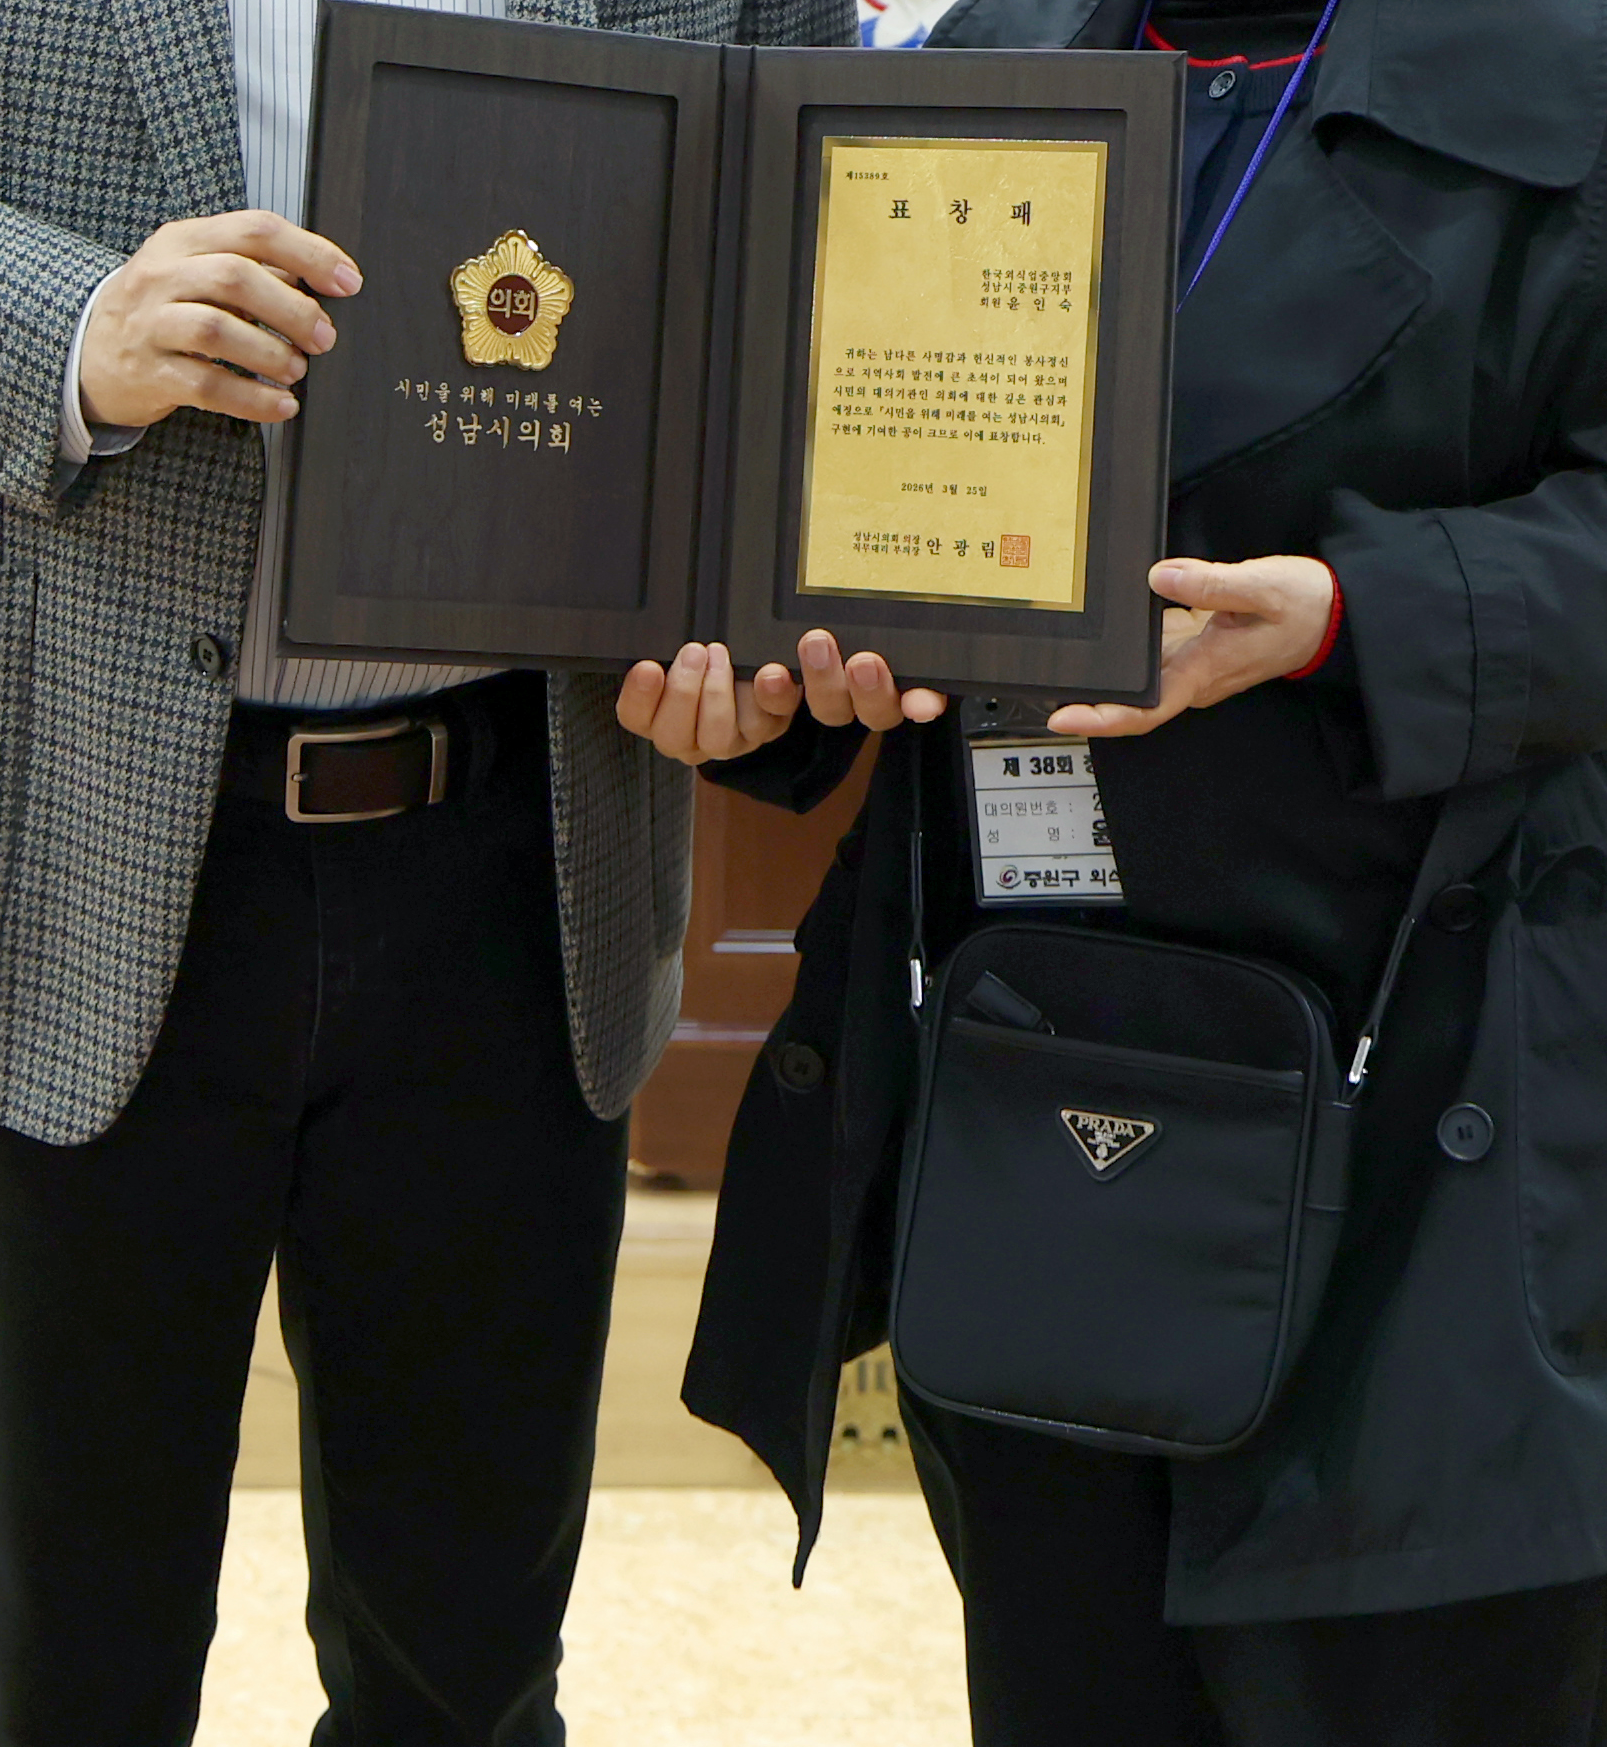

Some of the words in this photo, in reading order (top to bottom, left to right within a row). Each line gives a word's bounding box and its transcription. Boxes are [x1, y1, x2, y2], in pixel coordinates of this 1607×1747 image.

[981, 268, 1072, 283] 한국외식업중앙회
[981, 281, 1012, 293] 성남시
[1017, 282, 1072, 295] 중원구지부
[488, 288, 536, 321] 의회
[980, 296, 1001, 308] 회원
[845, 348, 877, 360] 귀하는
[884, 349, 916, 361] 남다른
[922, 351, 966, 364] 사명감과
[973, 353, 1016, 366] 헌신적인
[1024, 355, 1068, 368] 봉사정신
[834, 367, 855, 377] 으로
[862, 367, 905, 380] 지역사회
[912, 370, 944, 382] 발전에
[951, 371, 960, 383] 큰
[967, 372, 999, 384] 초석이
[1007, 374, 1028, 386] 되어
[1034, 374, 1067, 387] 왔으며
[394, 378, 451, 404] 시민을
[459, 385, 495, 408] 위해
[505, 389, 559, 414] 미래를
[568, 395, 603, 418] 여는
[834, 386, 866, 398] 시민의
[873, 387, 928, 400] 대의기관인
[936, 390, 968, 402] 의회에
[976, 392, 997, 404] 대한
[1005, 393, 1026, 405] 깊은
[1034, 394, 1067, 407] 관심과
[921, 408, 940, 420] 위해
[946, 409, 976, 422] 미래를
[982, 411, 1002, 423] 여는
[424, 410, 572, 455] 성남시의회
[831, 423, 861, 435] 구현에
[866, 425, 897, 437] 기여한
[902, 426, 922, 438] 공이
[927, 428, 958, 439] 크므로
[963, 429, 984, 441] 이에
[989, 431, 1045, 444] 표창합니다.
[900, 482, 934, 494] 2026년
[942, 484, 958, 495] 3월
[966, 485, 987, 497] 25일
[853, 531, 899, 543] 성남시의회
[903, 534, 920, 545] 의장
[1003, 756, 1021, 777] 제
[1030, 754, 1074, 775] 38회
[984, 801, 1059, 817] 대의원번호
[1023, 869, 1081, 888] 중원구
[1076, 1116, 1136, 1138] PRADA
